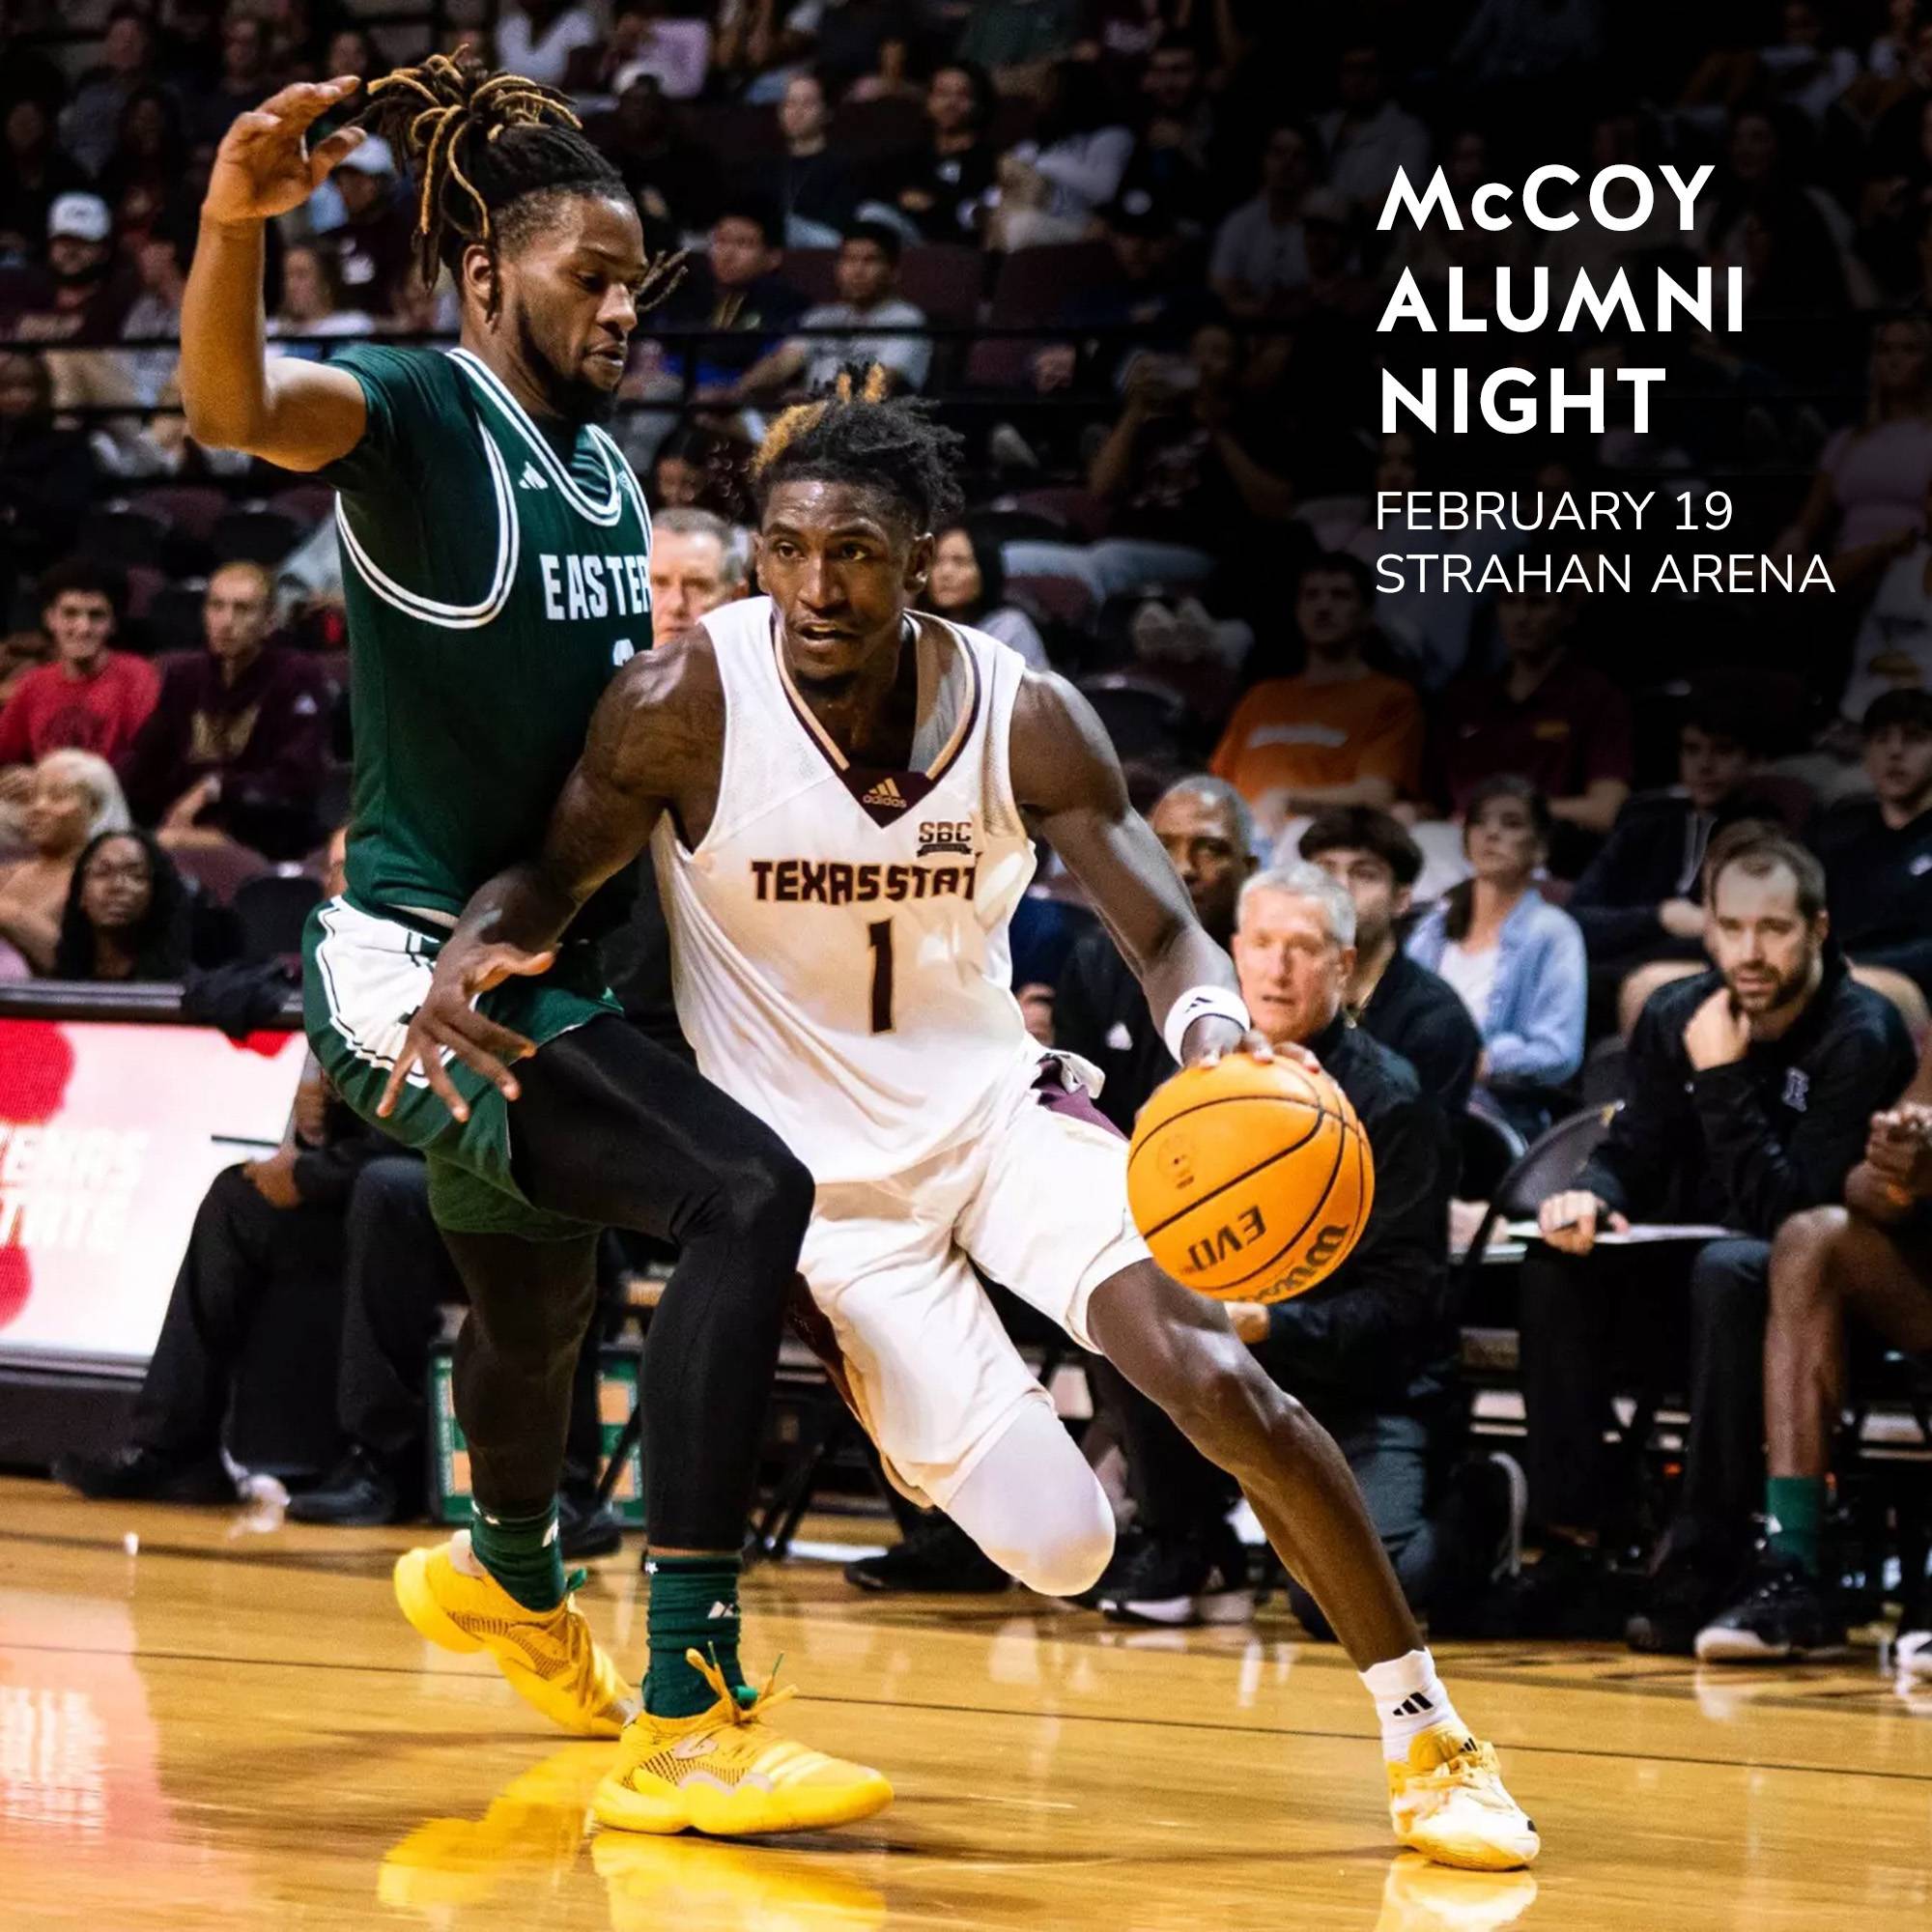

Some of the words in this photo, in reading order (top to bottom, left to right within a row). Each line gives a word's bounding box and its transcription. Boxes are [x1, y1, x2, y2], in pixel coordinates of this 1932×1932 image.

[918, 821, 972, 842] SBC
[884, 865, 979, 903] STAT
[868, 918, 895, 1034] 1
